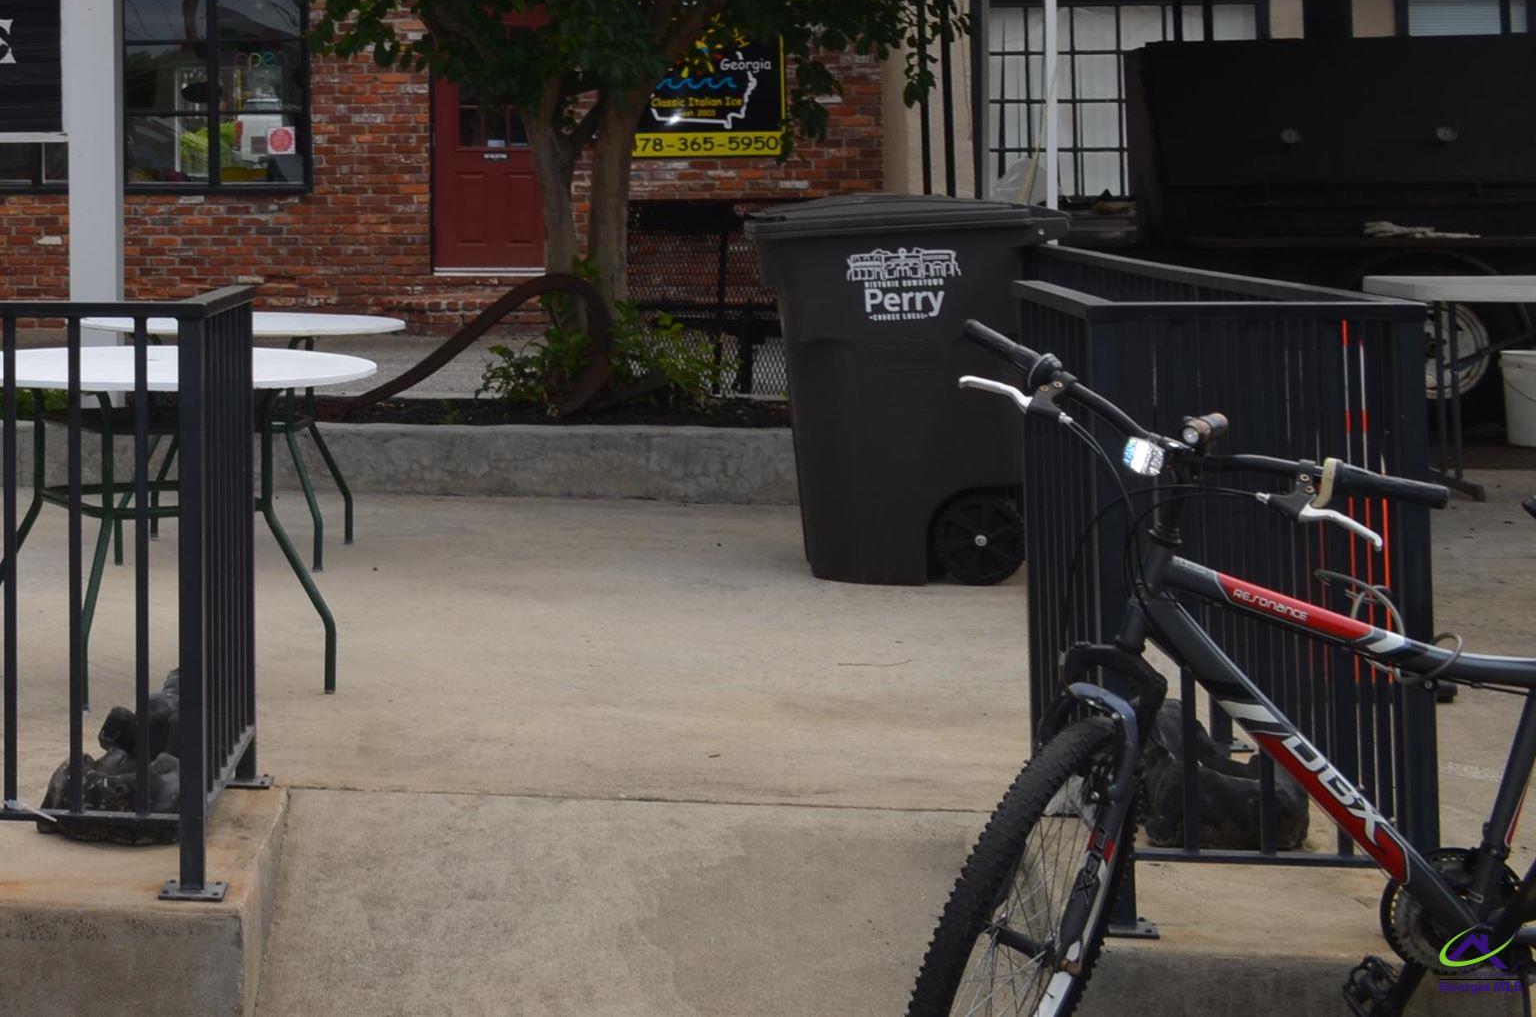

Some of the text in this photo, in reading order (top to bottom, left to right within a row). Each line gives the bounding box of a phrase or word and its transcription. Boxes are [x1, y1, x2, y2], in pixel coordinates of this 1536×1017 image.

[720, 58, 771, 75] Georgia
[651, 96, 743, 108] Classic Italian Ice
[864, 288, 945, 317] Perry
[1281, 735, 1386, 845] DBX
